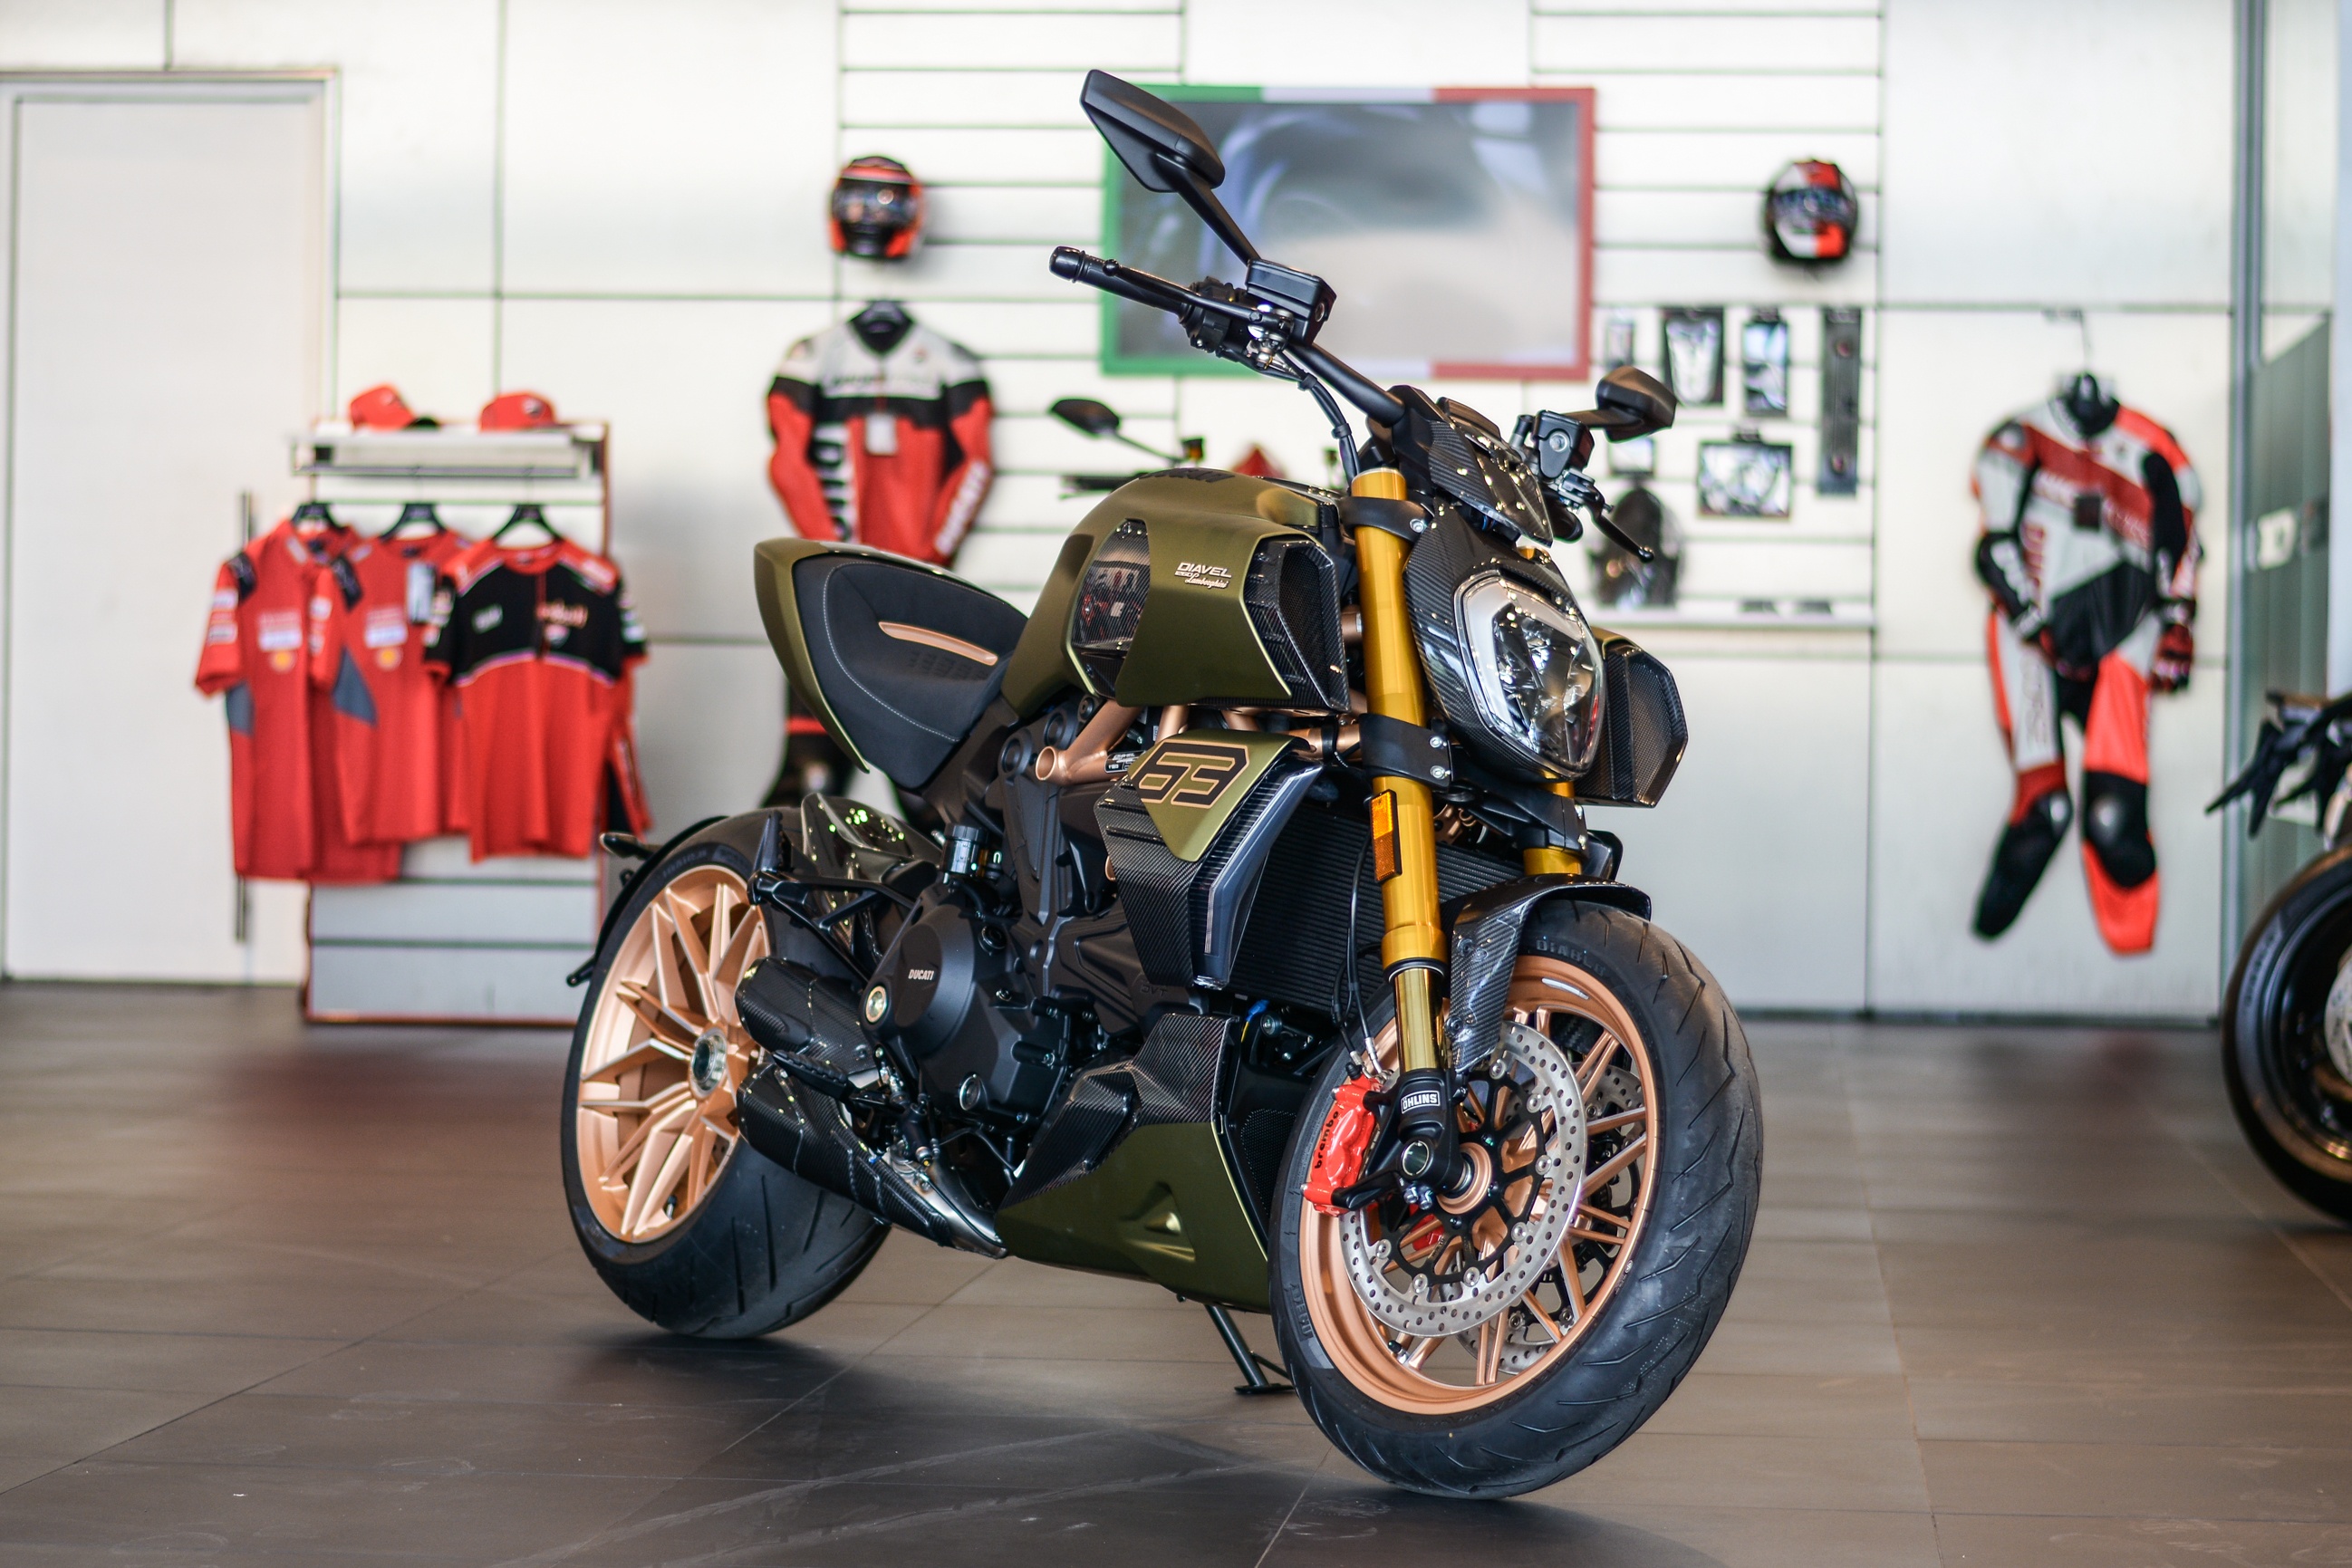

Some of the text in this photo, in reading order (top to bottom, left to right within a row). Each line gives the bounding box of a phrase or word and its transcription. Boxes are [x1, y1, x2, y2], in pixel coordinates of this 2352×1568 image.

[1177, 562, 1232, 578] DIAVEL
[1185, 572, 1229, 589] Lamborghini
[1130, 739, 1249, 809] 63
[1536, 938, 1606, 977] DIABLO
[908, 969, 935, 981] DUCATI
[1402, 1092, 1438, 1110] ÖHLINS
[1314, 1111, 1338, 1169] brembo
